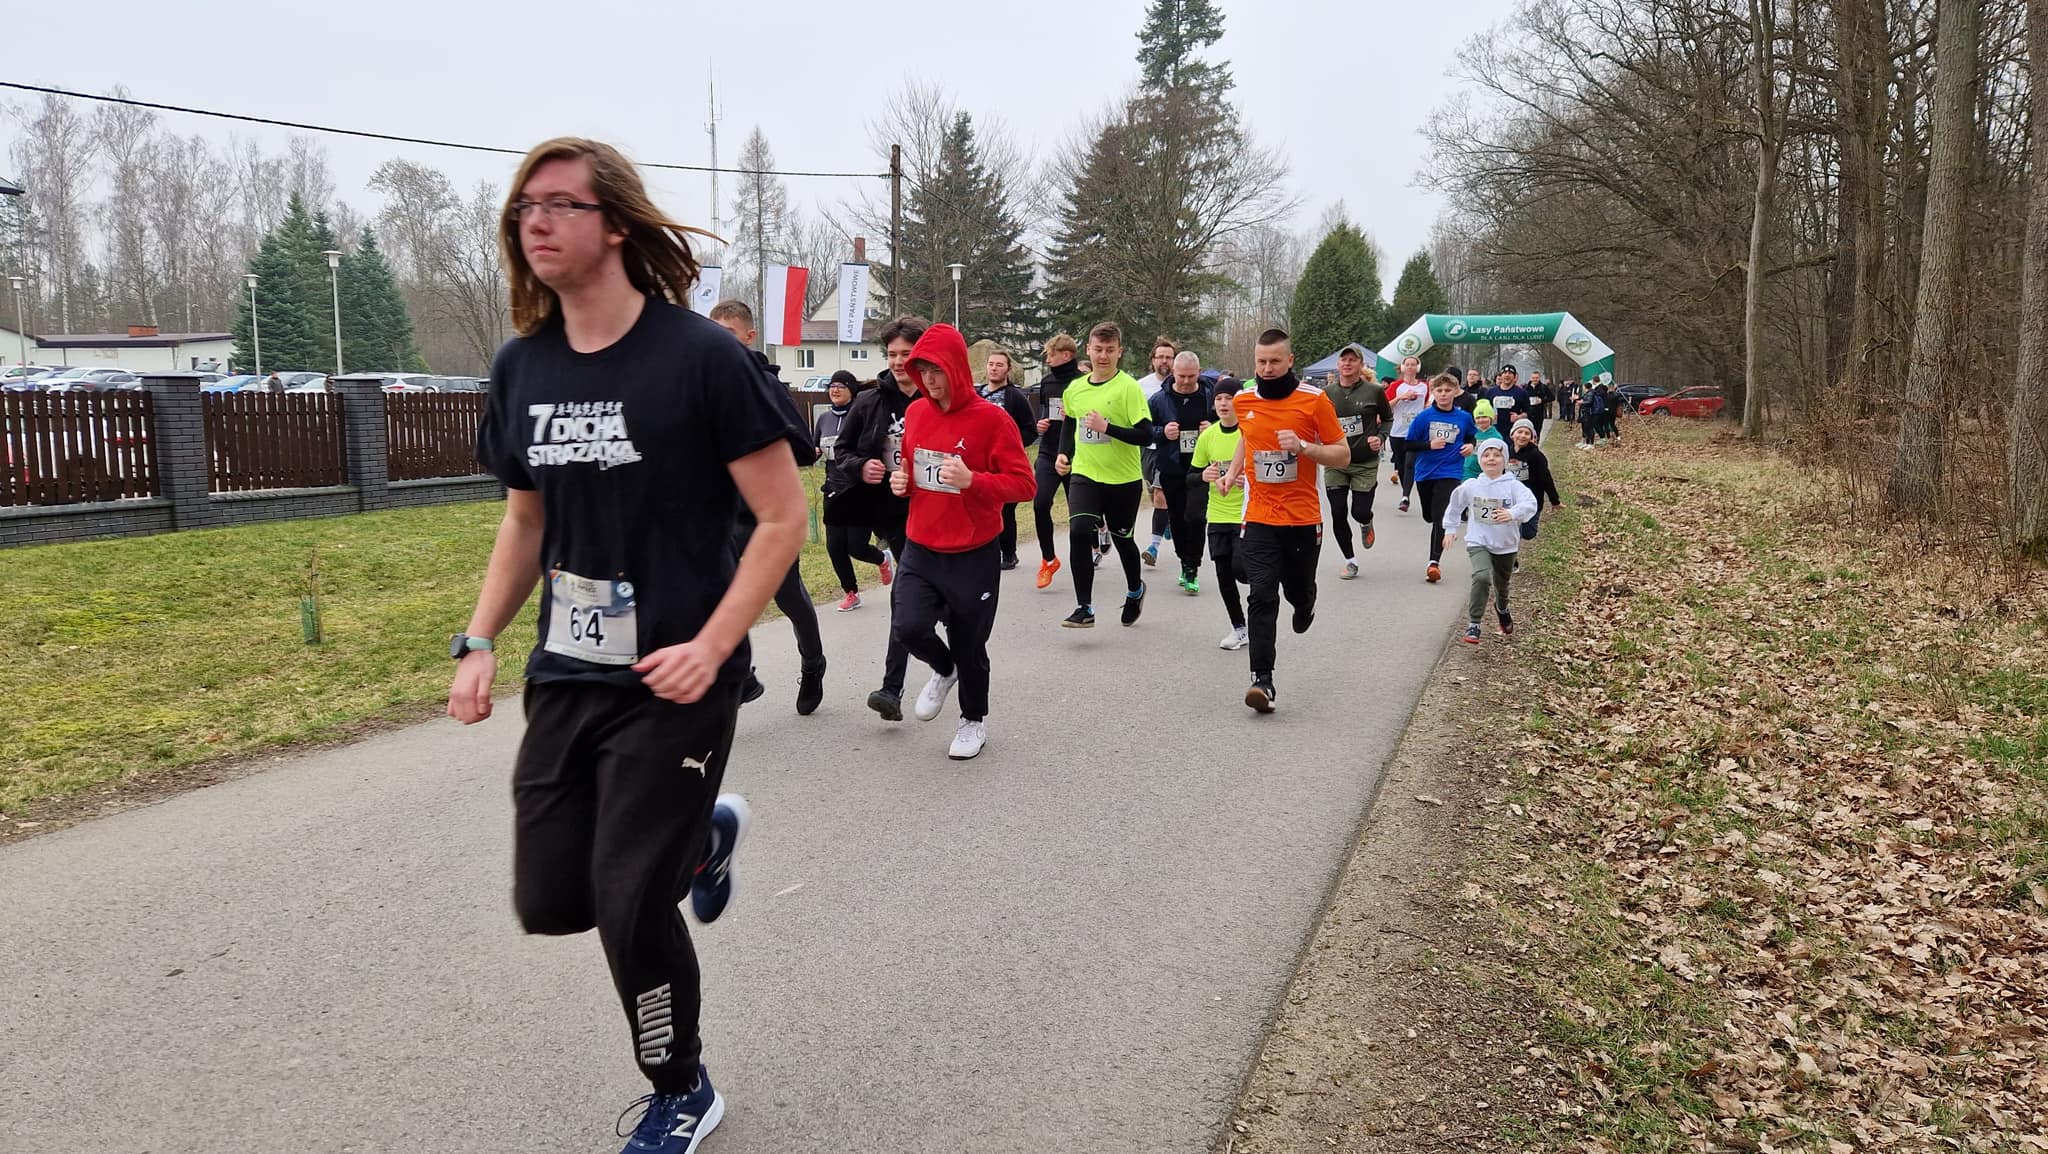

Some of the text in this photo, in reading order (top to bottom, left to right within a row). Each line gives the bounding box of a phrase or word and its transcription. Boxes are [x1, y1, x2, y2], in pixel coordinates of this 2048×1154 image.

[1471, 326, 1491, 335] Lasy
[1494, 325, 1544, 333] Państwowe
[528, 403, 628, 443] 7 DYCHA
[1436, 429, 1450, 439] 60
[1181, 438, 1196, 449] 19
[1263, 462, 1286, 477] 79
[569, 605, 606, 648] 64
[637, 982, 675, 1066] PUMA
